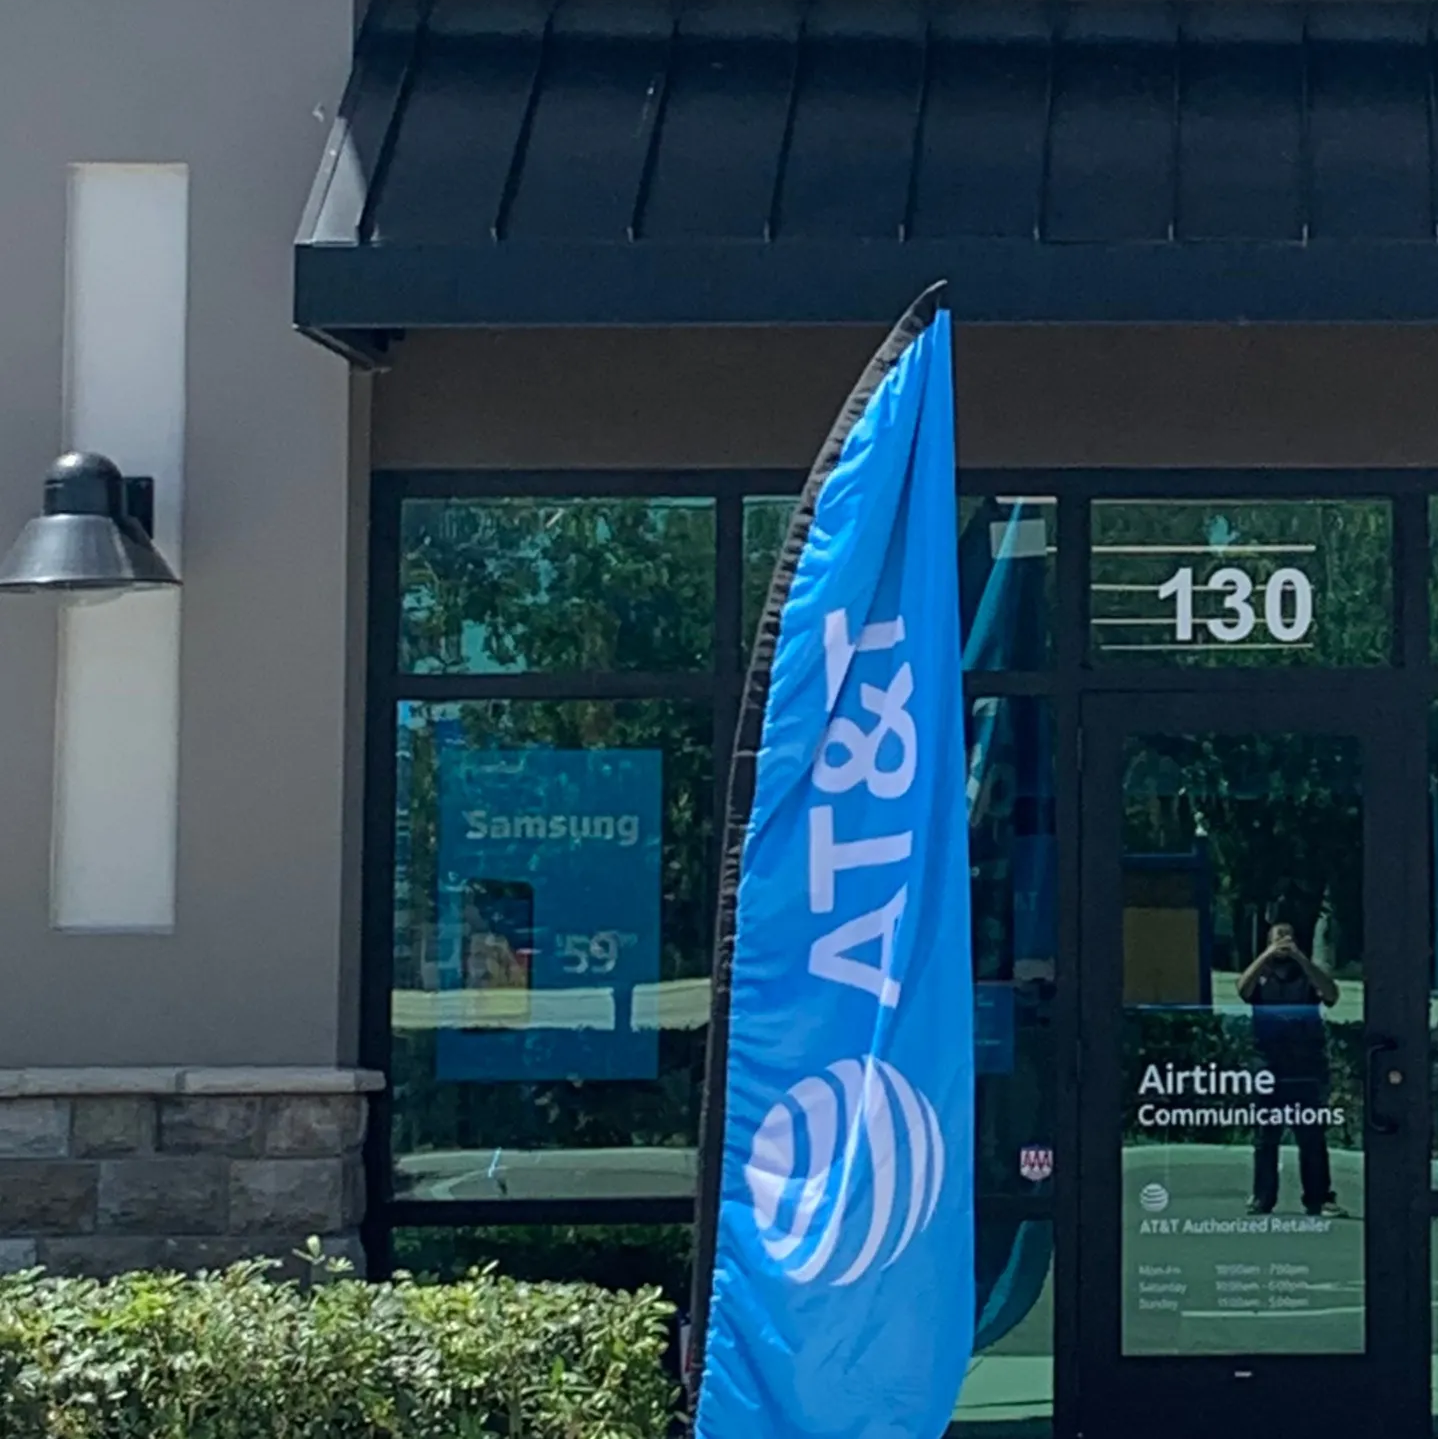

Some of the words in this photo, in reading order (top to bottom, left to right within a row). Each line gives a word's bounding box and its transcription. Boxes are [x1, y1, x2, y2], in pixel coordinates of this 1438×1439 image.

[1158, 567, 1313, 642] 130
[808, 608, 918, 1009] AT&T
[466, 810, 639, 846] Samsung
[1138, 1063, 1276, 1094] Airtime
[1138, 1103, 1345, 1126] Communications
[1140, 1219, 1179, 1234] AT&T
[1182, 1218, 1268, 1234] Authorized
[1271, 1218, 1331, 1233] Retailer
